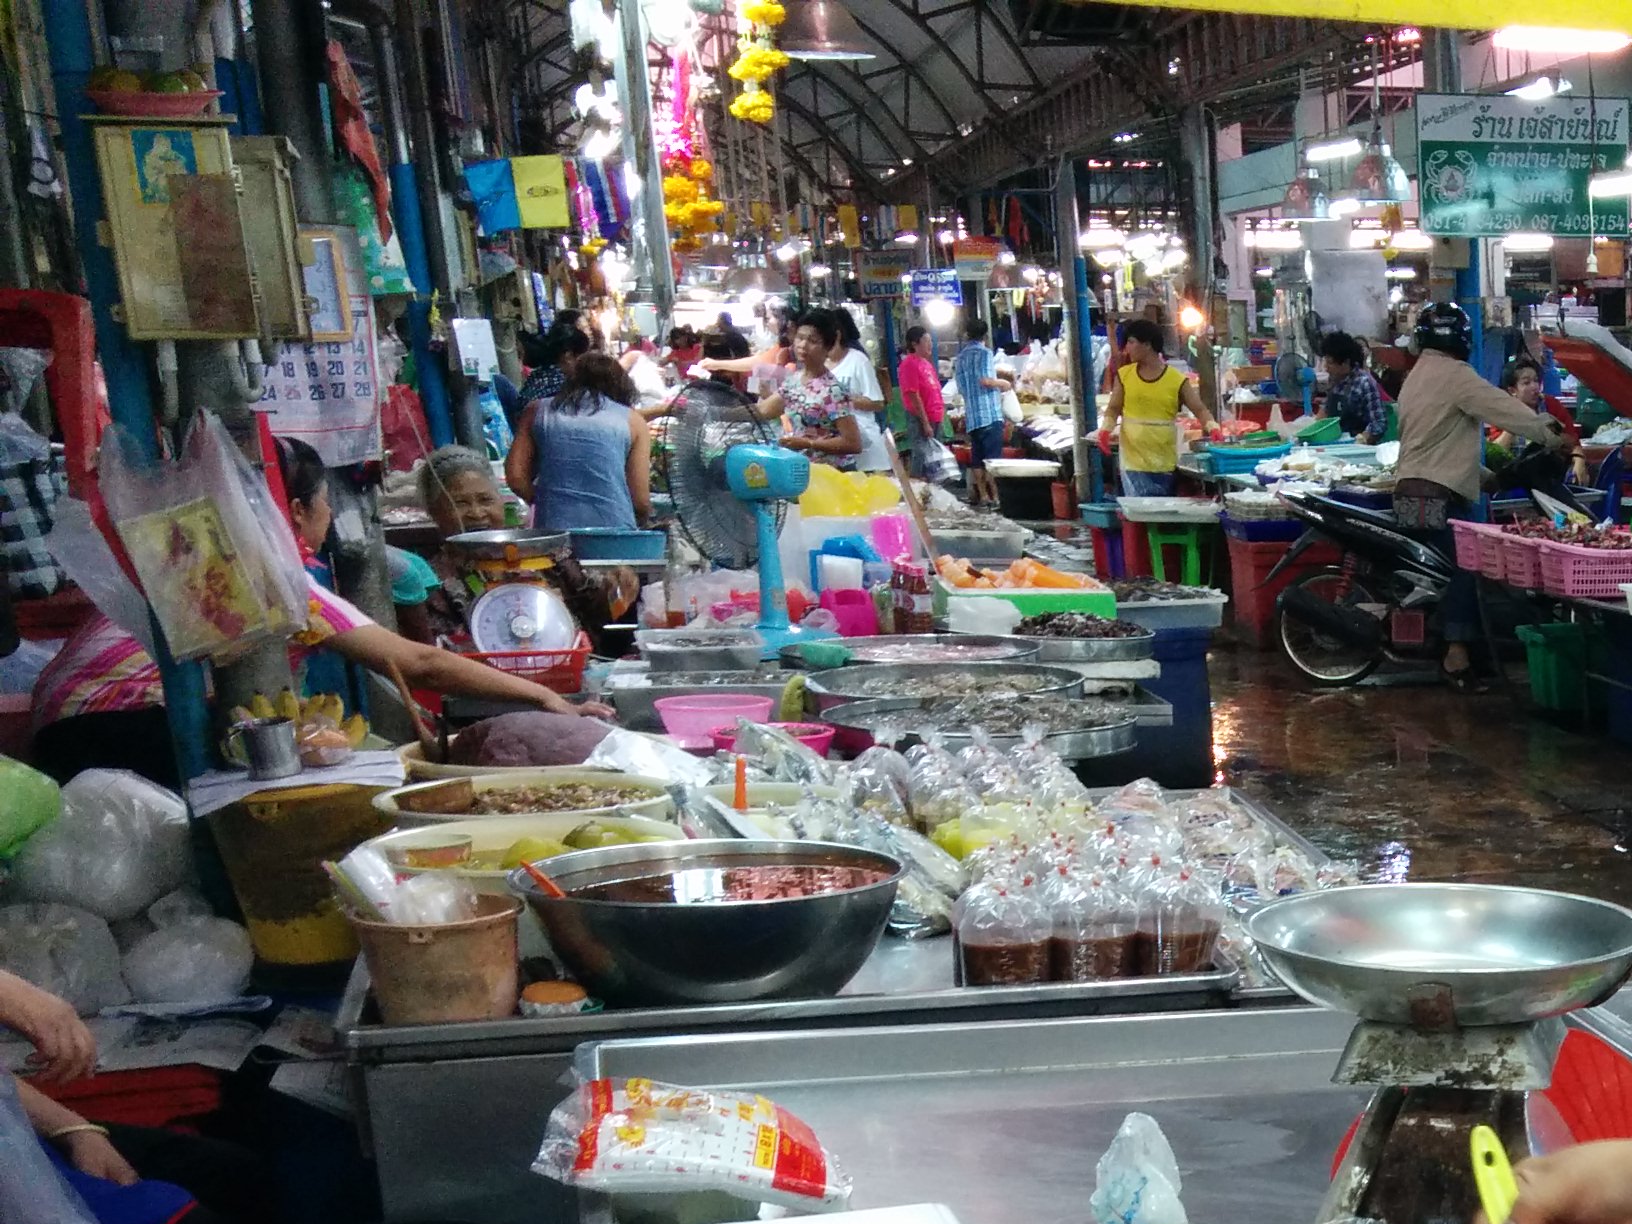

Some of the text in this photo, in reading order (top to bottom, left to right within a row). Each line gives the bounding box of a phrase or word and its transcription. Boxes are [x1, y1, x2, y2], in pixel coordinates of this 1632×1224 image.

[1472, 105, 1513, 139] ร้าน
[282, 361, 296, 378] 18
[305, 361, 319, 378] 19
[327, 360, 344, 377] 20
[354, 361, 369, 376] 21
[308, 384, 325, 401] 26
[330, 382, 346, 399] 27
[354, 381, 371, 397] 28
